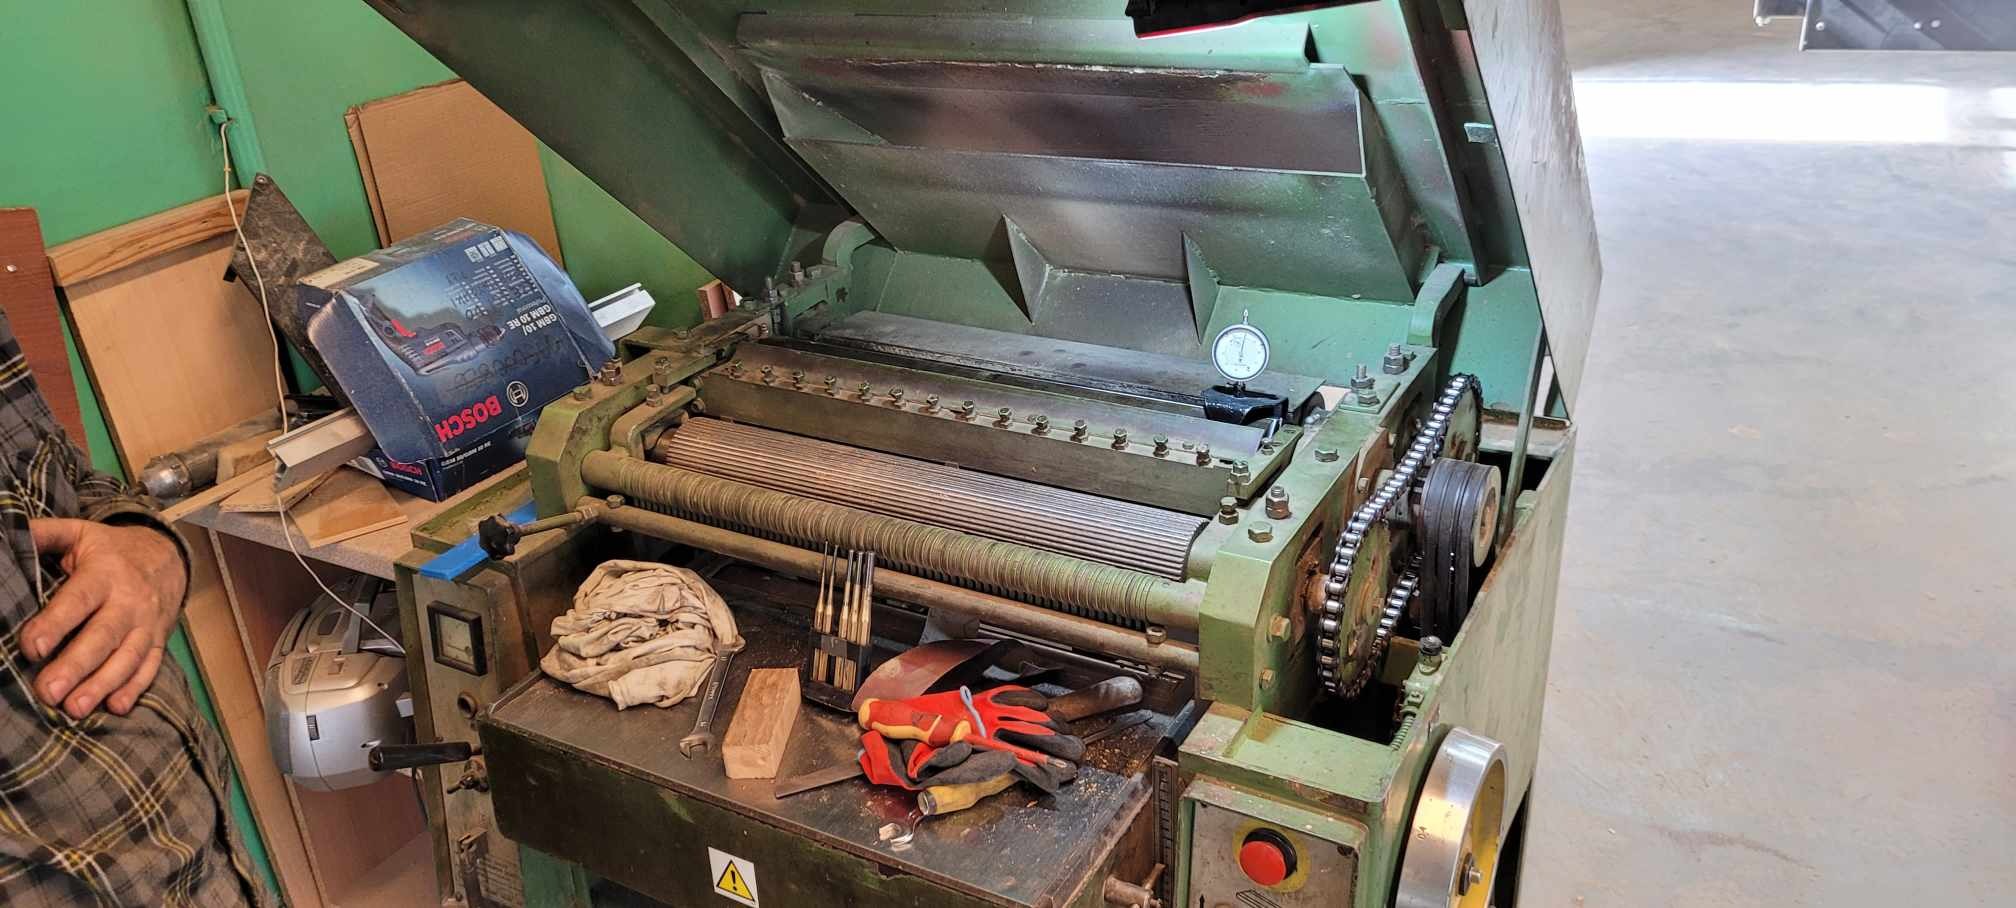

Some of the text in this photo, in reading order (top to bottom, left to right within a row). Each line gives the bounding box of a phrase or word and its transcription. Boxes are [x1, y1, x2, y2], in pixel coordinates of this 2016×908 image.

[520, 313, 532, 324] 10
[529, 304, 551, 319] GBM
[506, 318, 521, 330] RE
[522, 313, 557, 336] GBM 10/
[434, 395, 502, 442] BOSCH
